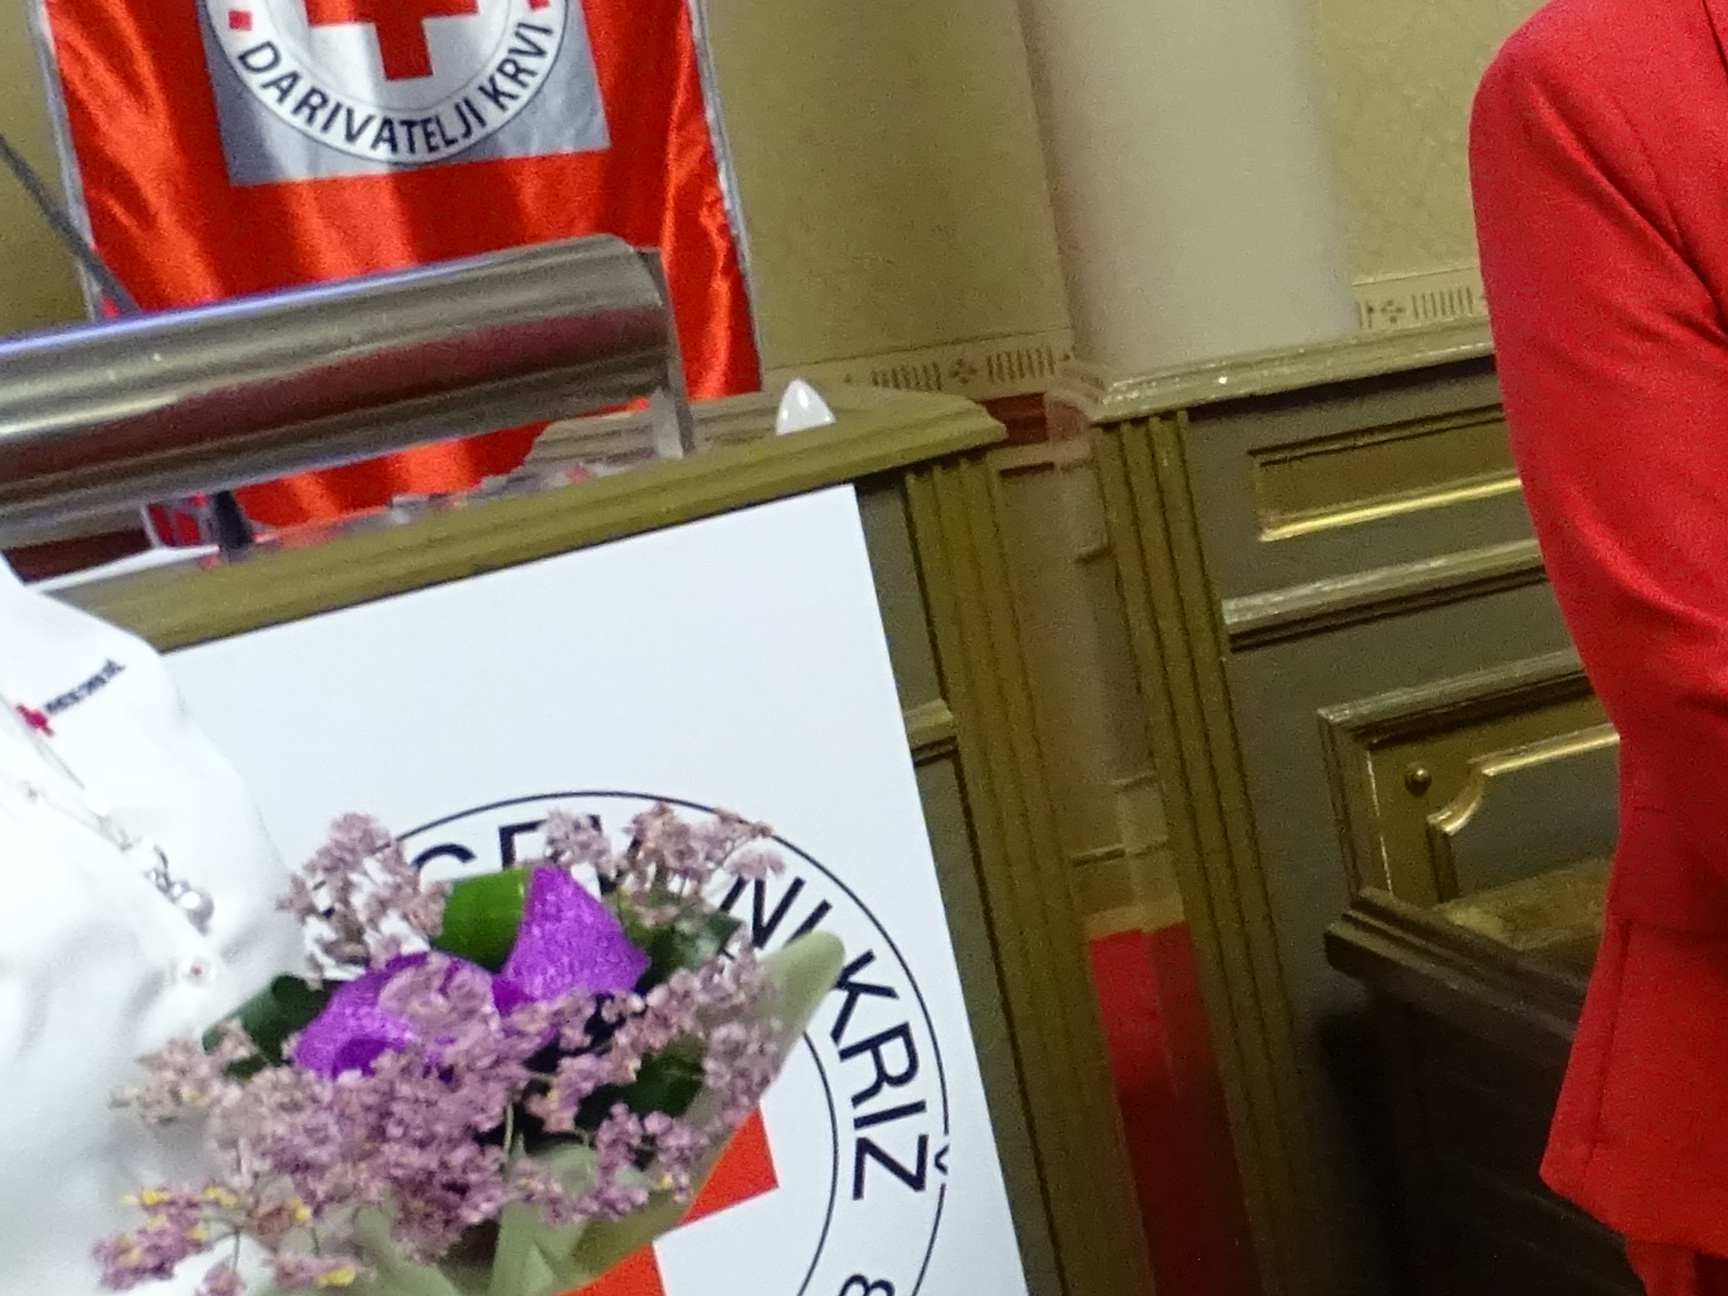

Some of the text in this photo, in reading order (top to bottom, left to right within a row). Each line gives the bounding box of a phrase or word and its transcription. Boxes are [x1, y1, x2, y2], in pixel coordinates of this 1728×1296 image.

[238, 22, 554, 154] DARIVATELJI KRVI
[831, 951, 951, 1202] KRIŽ
